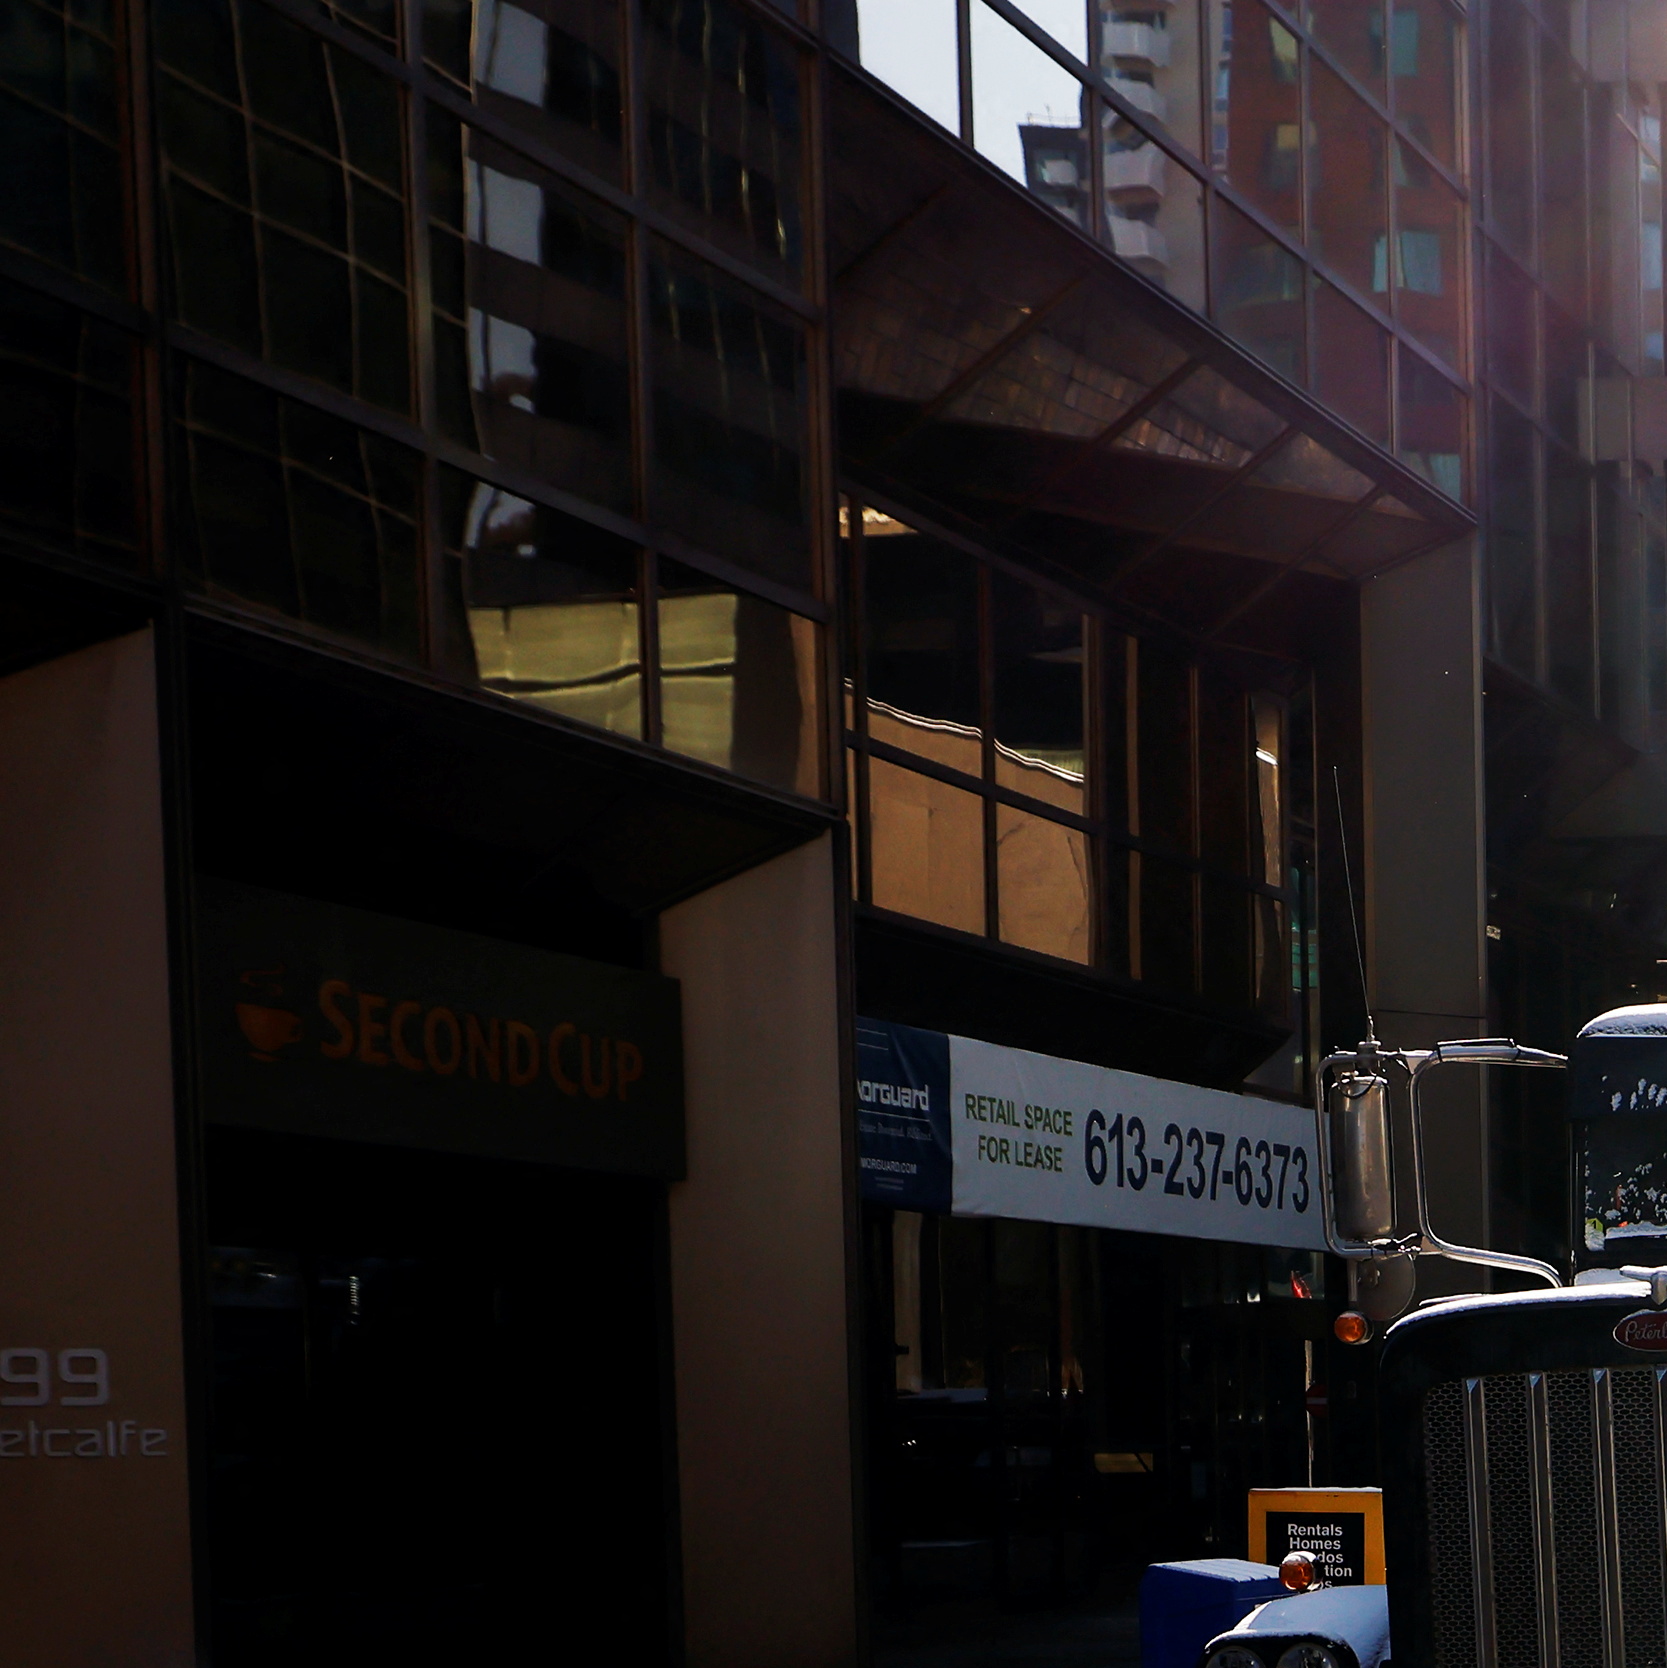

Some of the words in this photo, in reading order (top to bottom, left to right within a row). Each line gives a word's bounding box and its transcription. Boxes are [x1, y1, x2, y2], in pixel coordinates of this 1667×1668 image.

[318, 978, 541, 1087] SECOND
[548, 1021, 644, 1101] CUP
[965, 1093, 1021, 1127] RETAIL
[1024, 1104, 1073, 1136] SPACE
[978, 1135, 1011, 1164] FOR
[1015, 1141, 1063, 1172] LEASE
[1084, 1108, 1310, 1214] 613-237-6373
[0, 1348, 110, 1406] 99
[0, 1420, 168, 1457] etcalfe
[1287, 1523, 1343, 1536] Rentals
[1289, 1537, 1341, 1550] Homes
[1316, 1551, 1344, 1564] dos
